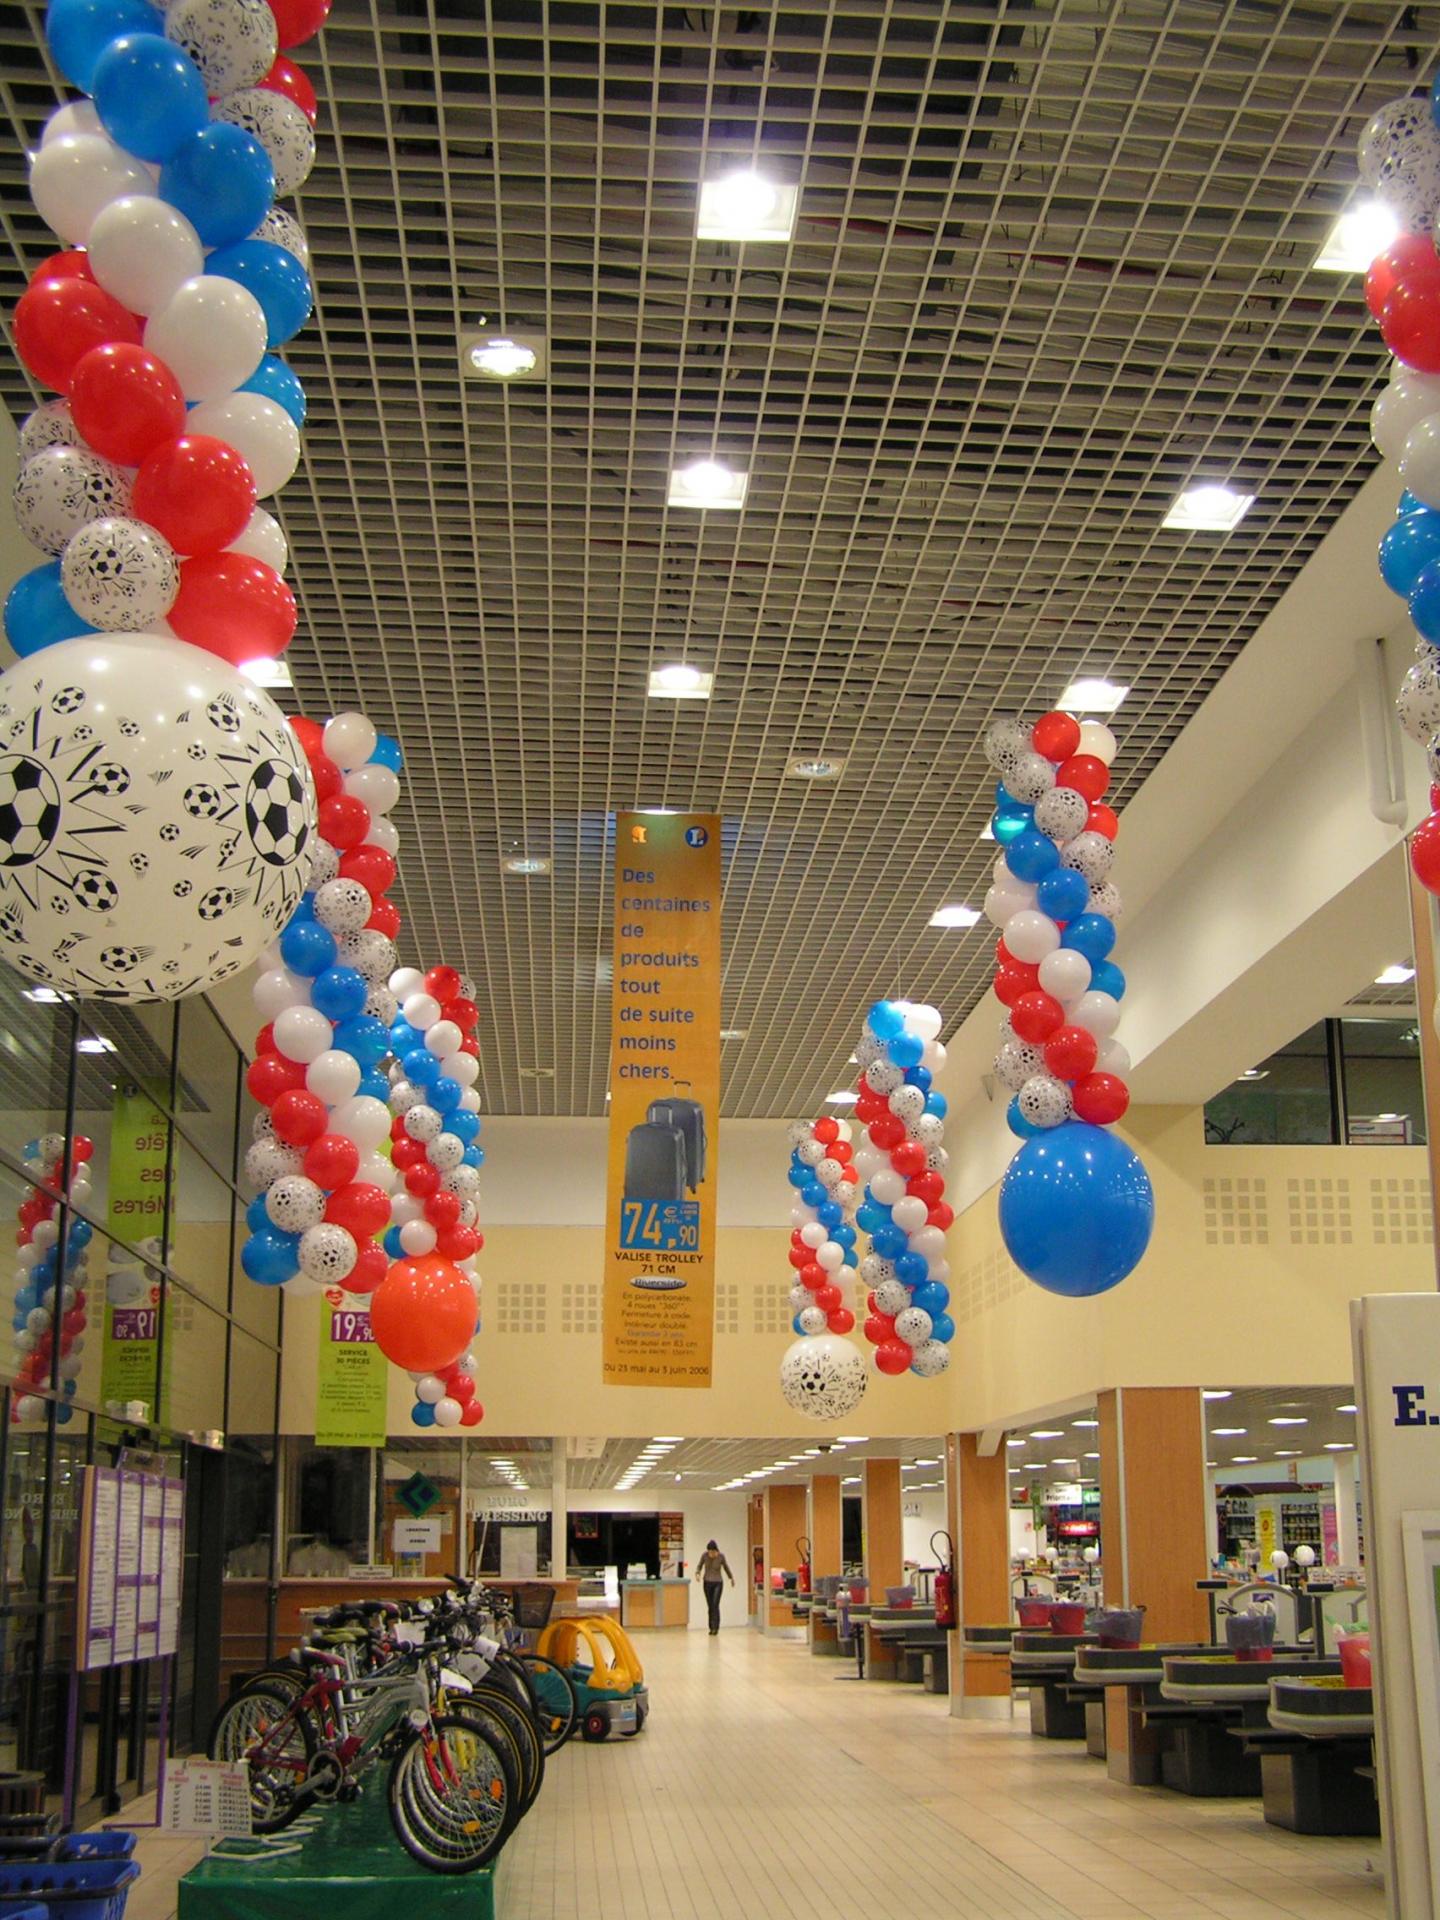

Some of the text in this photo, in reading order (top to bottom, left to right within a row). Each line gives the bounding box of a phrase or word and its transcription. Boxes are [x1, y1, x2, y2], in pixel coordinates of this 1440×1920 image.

[622, 868, 655, 884] Des
[621, 896, 711, 912] centaines
[621, 923, 644, 938] de
[620, 951, 700, 967] produits
[620, 979, 661, 994] tout
[619, 1007, 694, 1023] de suite
[619, 1035, 677, 1051] moins
[618, 1063, 675, 1080] chers.
[615, 1251, 704, 1264] VALISE TROLLEY
[641, 1264, 676, 1274] 71 CM
[604, 1363, 616, 1372] Du
[630, 1364, 647, 1373] mai
[669, 1366, 687, 1376] juin
[473, 1510, 548, 1522] PRESSING
